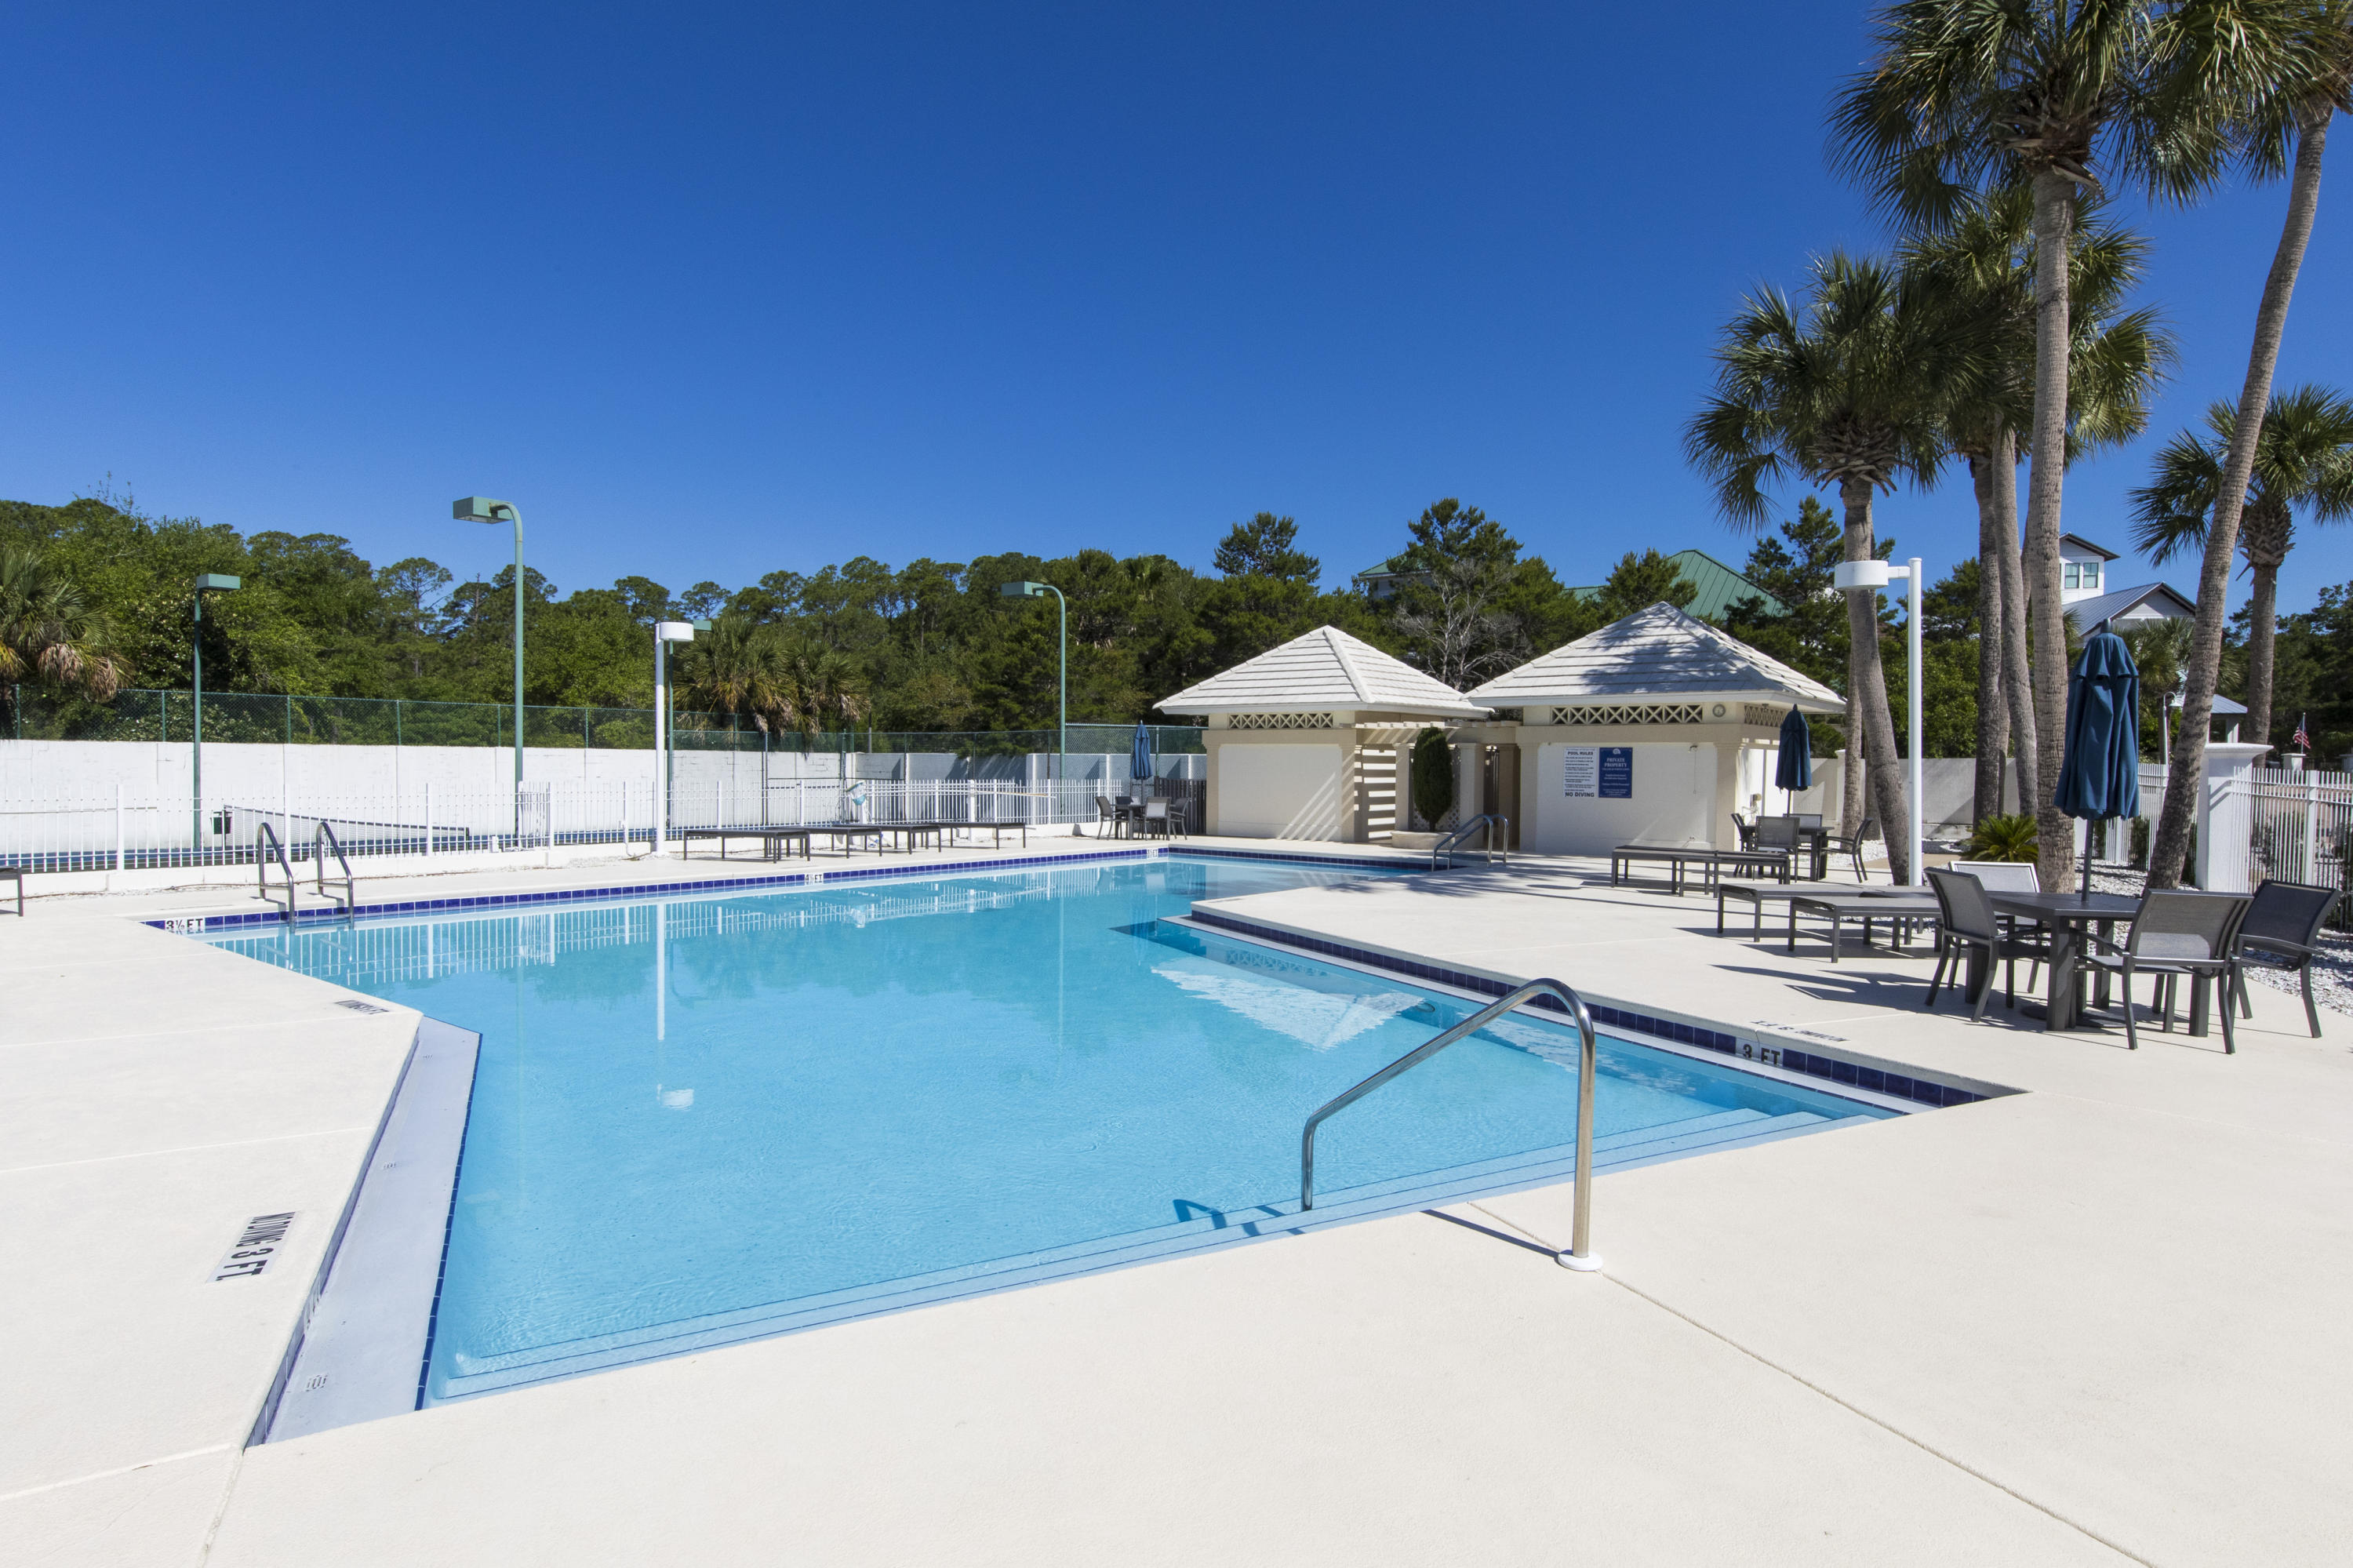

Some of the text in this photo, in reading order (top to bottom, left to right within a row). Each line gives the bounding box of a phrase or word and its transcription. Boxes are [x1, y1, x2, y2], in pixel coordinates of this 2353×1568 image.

[187, 918, 203, 930] FT
[1743, 1043, 1780, 1065] 3 FT
[231, 1248, 275, 1259] 3
